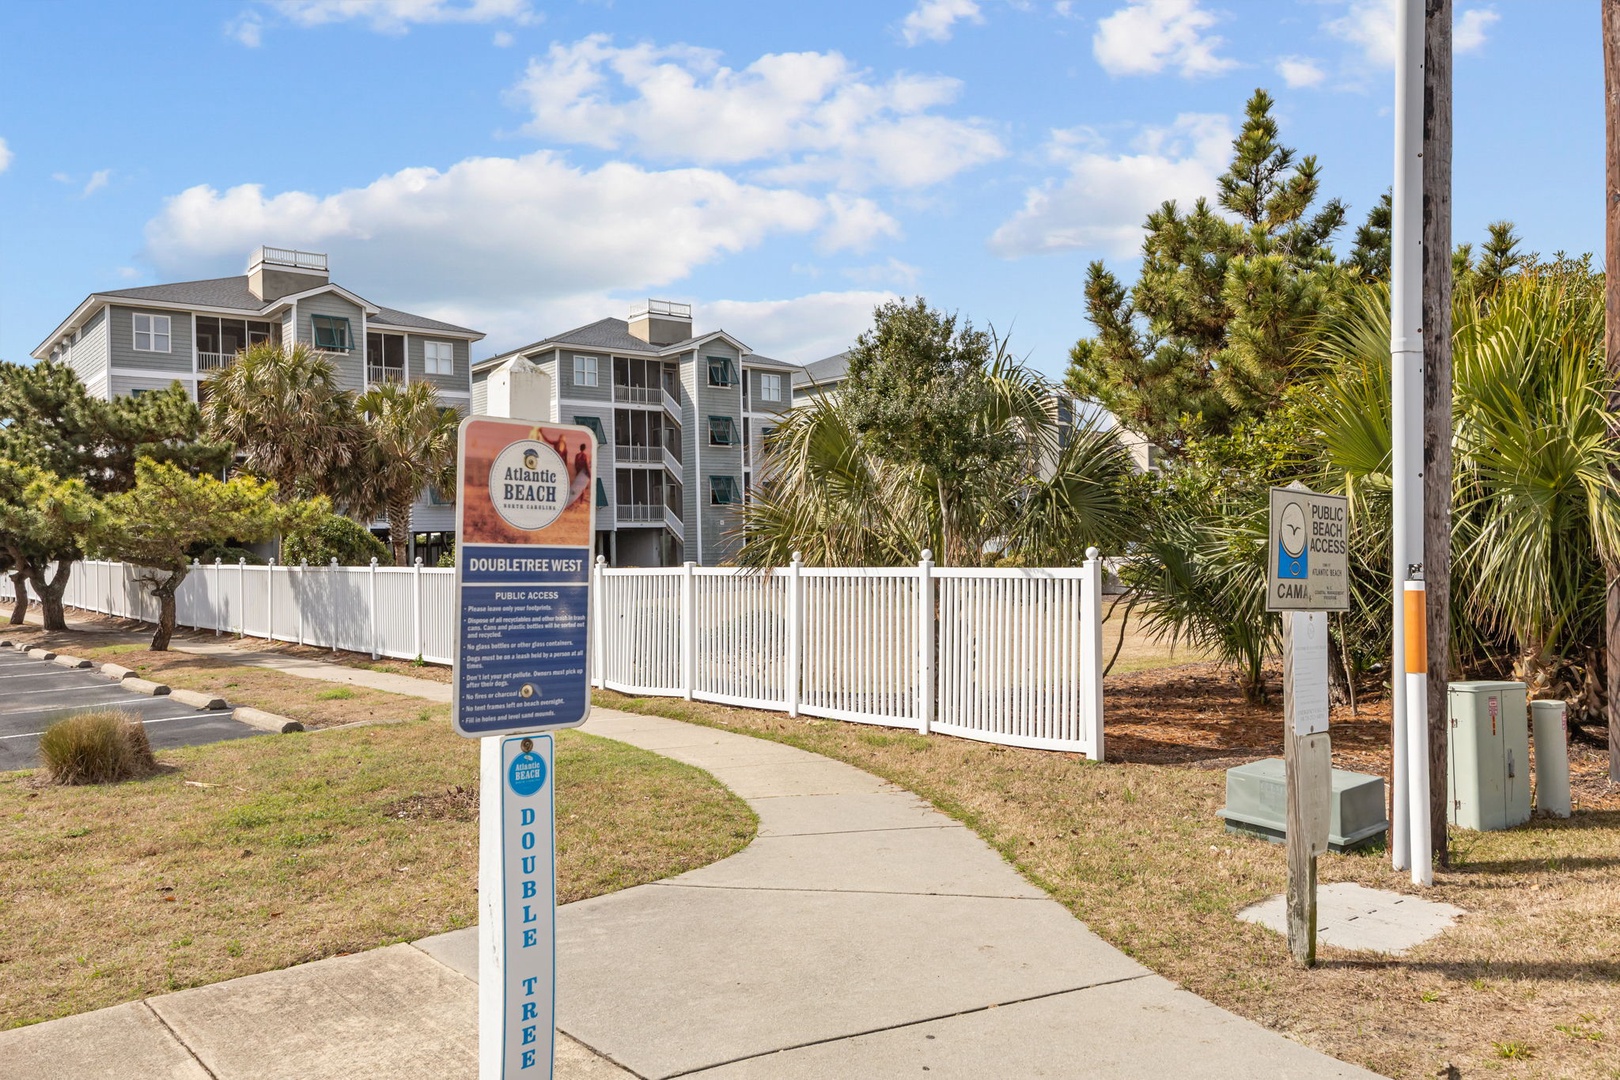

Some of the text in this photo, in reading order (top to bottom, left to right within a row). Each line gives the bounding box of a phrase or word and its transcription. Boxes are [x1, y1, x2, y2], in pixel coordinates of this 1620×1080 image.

[504, 467, 556, 483] Atlantic
[504, 484, 556, 502] BEACH
[1312, 505, 1344, 522] PUBLIC
[1313, 522, 1342, 538] BEACH
[1310, 538, 1346, 554] ACCESS
[470, 558, 582, 572] DOUBLETREE WEST
[496, 592, 526, 600] PUBLIC
[1278, 583, 1308, 598] CAMA
[515, 769, 540, 780] BEACH
[516, 762, 540, 771] Atlantic
[520, 808, 538, 1070] DOUBLE TREE
